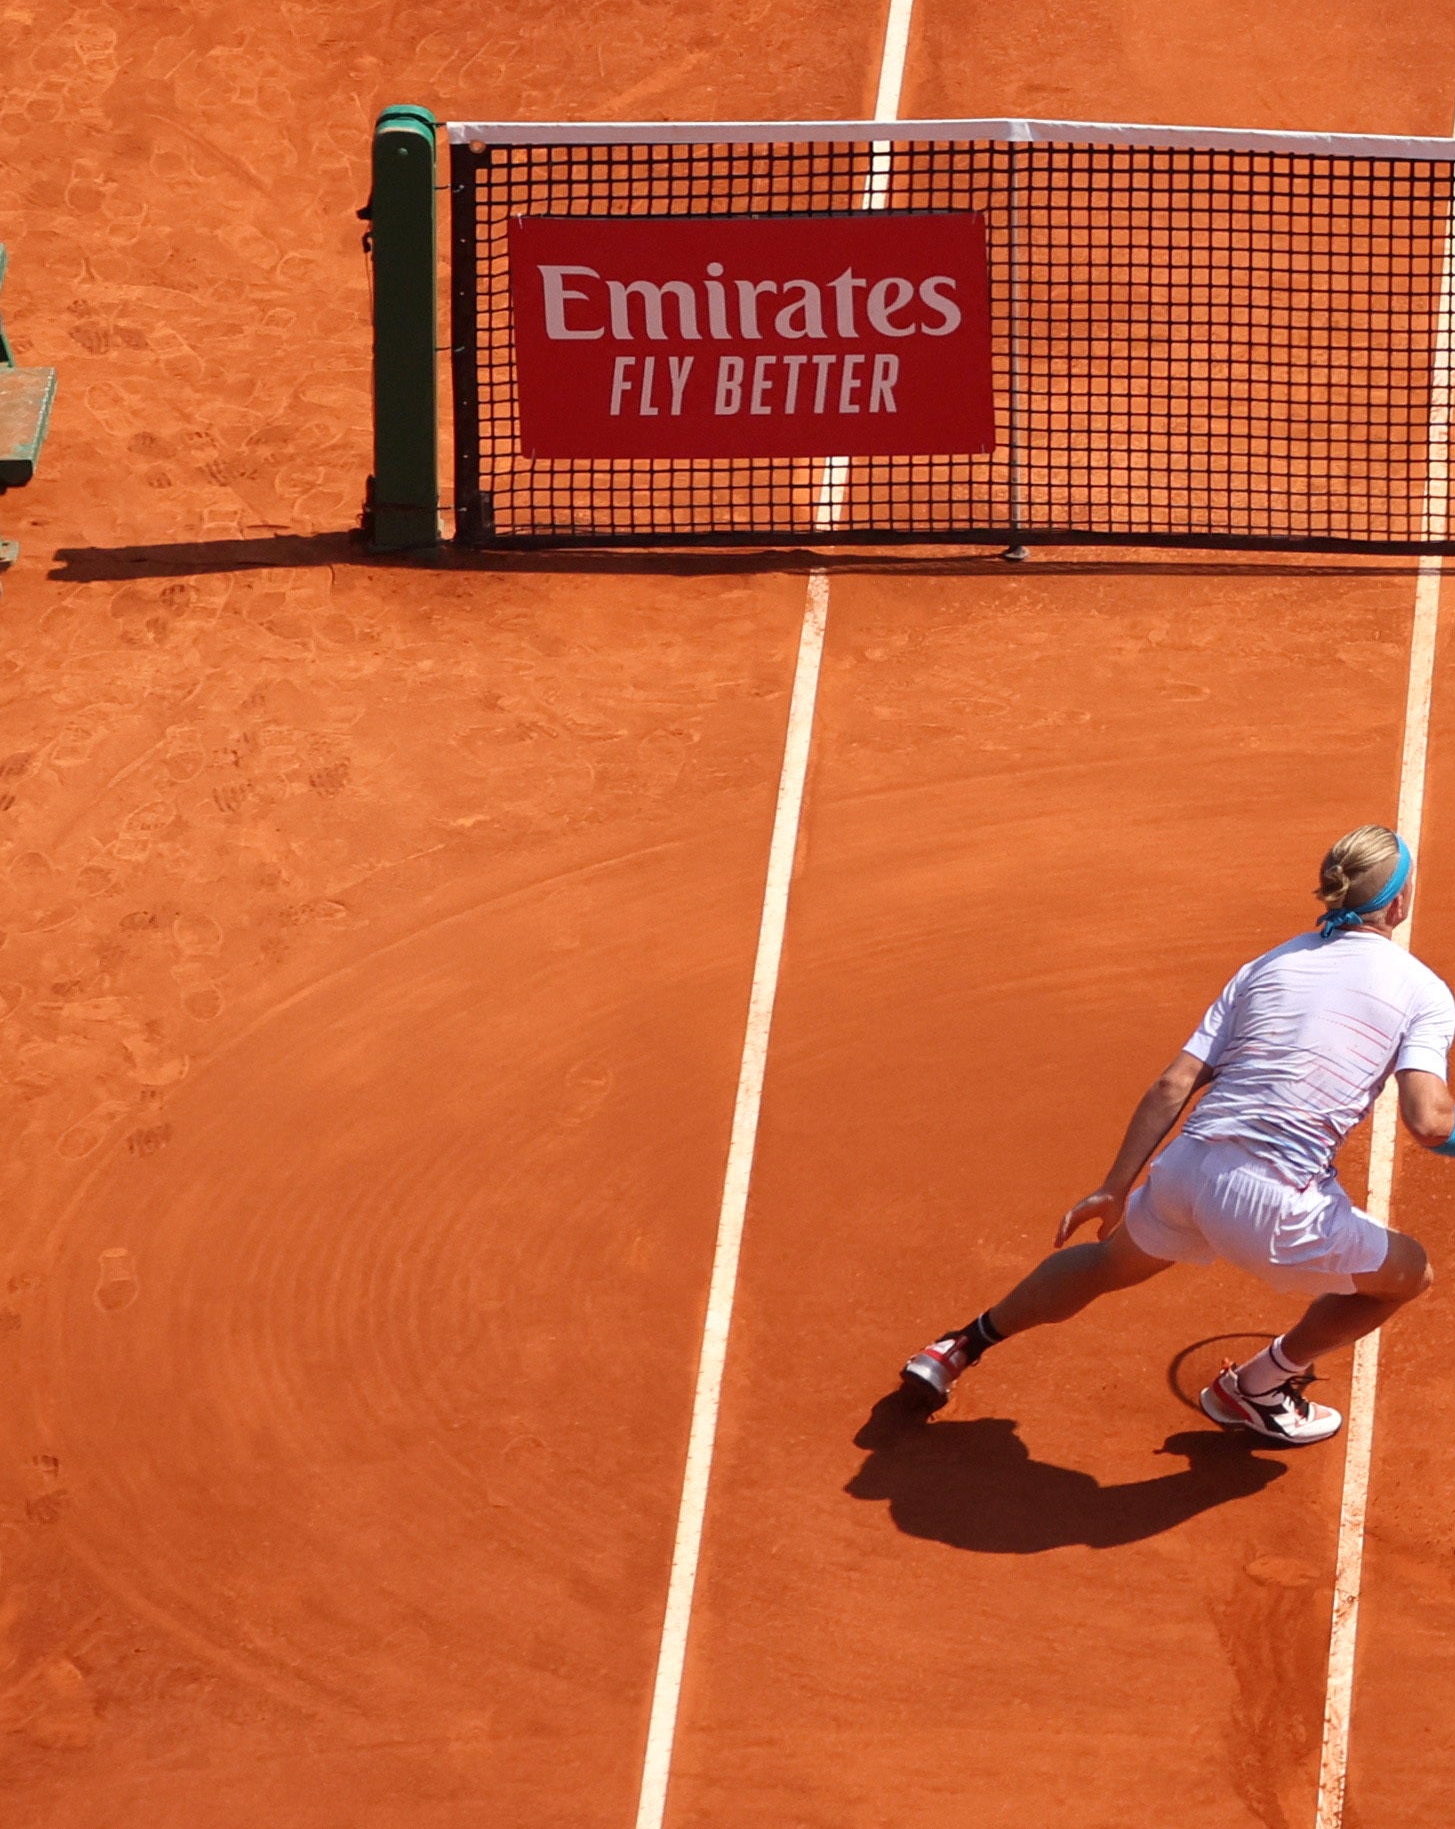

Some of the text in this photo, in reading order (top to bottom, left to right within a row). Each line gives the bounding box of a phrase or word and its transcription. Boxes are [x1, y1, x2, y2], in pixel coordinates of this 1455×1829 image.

[536, 262, 962, 340] Emirates
[609, 354, 900, 416] FLY BETTER
